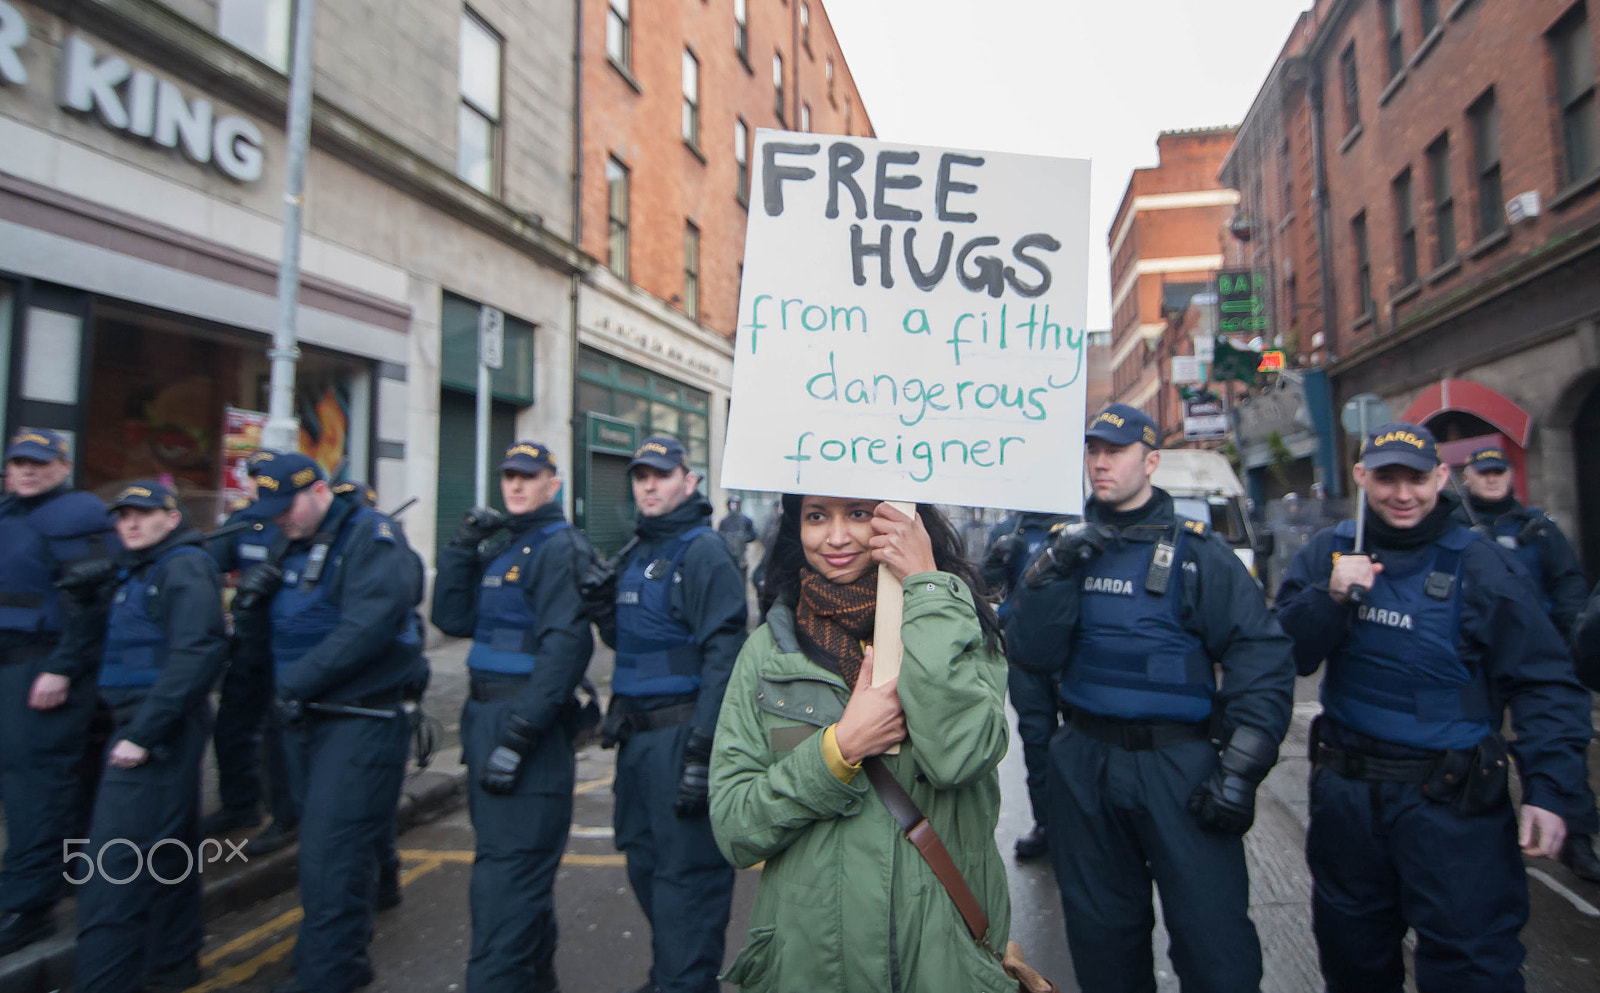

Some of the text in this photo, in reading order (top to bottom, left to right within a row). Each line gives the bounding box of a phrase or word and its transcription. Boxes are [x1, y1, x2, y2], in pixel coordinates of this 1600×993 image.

[62, 36, 264, 182] KING
[762, 142, 985, 222] FREE
[850, 224, 1061, 298] HUGS
[742, 295, 867, 355] from
[903, 309, 931, 335] a
[946, 304, 1084, 388] filthy
[806, 351, 1048, 425] dangerous
[784, 431, 1025, 484] foreigner
[1374, 430, 1426, 450] GARDA
[1084, 576, 1134, 595] GARDA
[1358, 604, 1414, 631] GARDA
